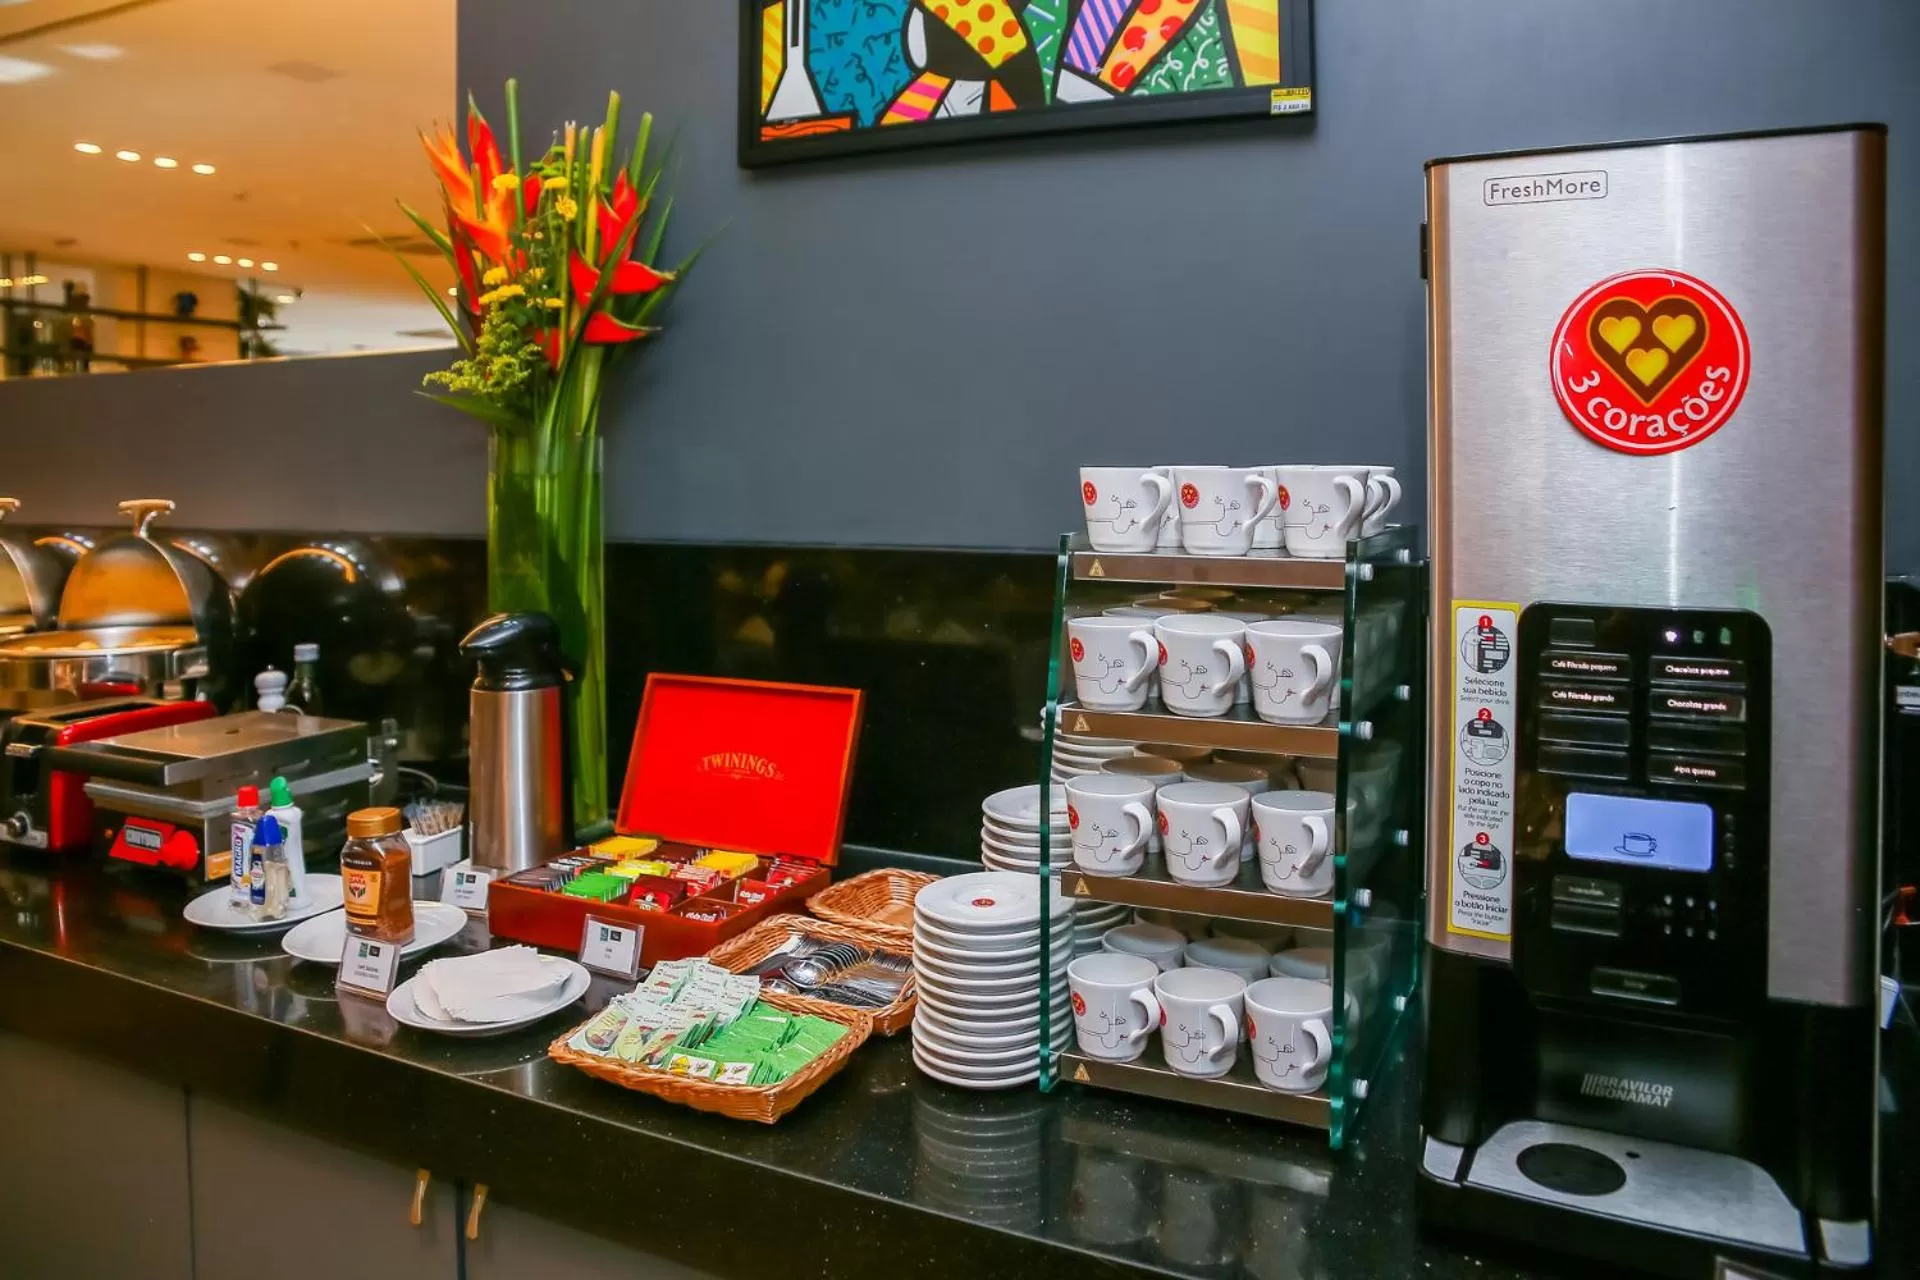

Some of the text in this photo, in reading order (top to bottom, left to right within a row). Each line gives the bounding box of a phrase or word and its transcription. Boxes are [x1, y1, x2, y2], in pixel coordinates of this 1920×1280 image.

[1490, 179, 1601, 199] FreshMore
[1568, 366, 1731, 437] 3 corações
[1465, 676, 1504, 687] Selecione
[1478, 687, 1507, 697] bebida
[702, 752, 777, 778] TWININGS
[1465, 768, 1501, 779] Posicione
[1470, 779, 1490, 788] copo
[1491, 781, 1503, 789] no
[1458, 785, 1510, 799] lado indicado
[1468, 796, 1499, 807] pela luz
[234, 838, 243, 876] MAGRO
[1463, 890, 1501, 902] Pressione
[1461, 900, 1484, 910] botão
[1595, 1087, 1671, 1108] BONAMAT
